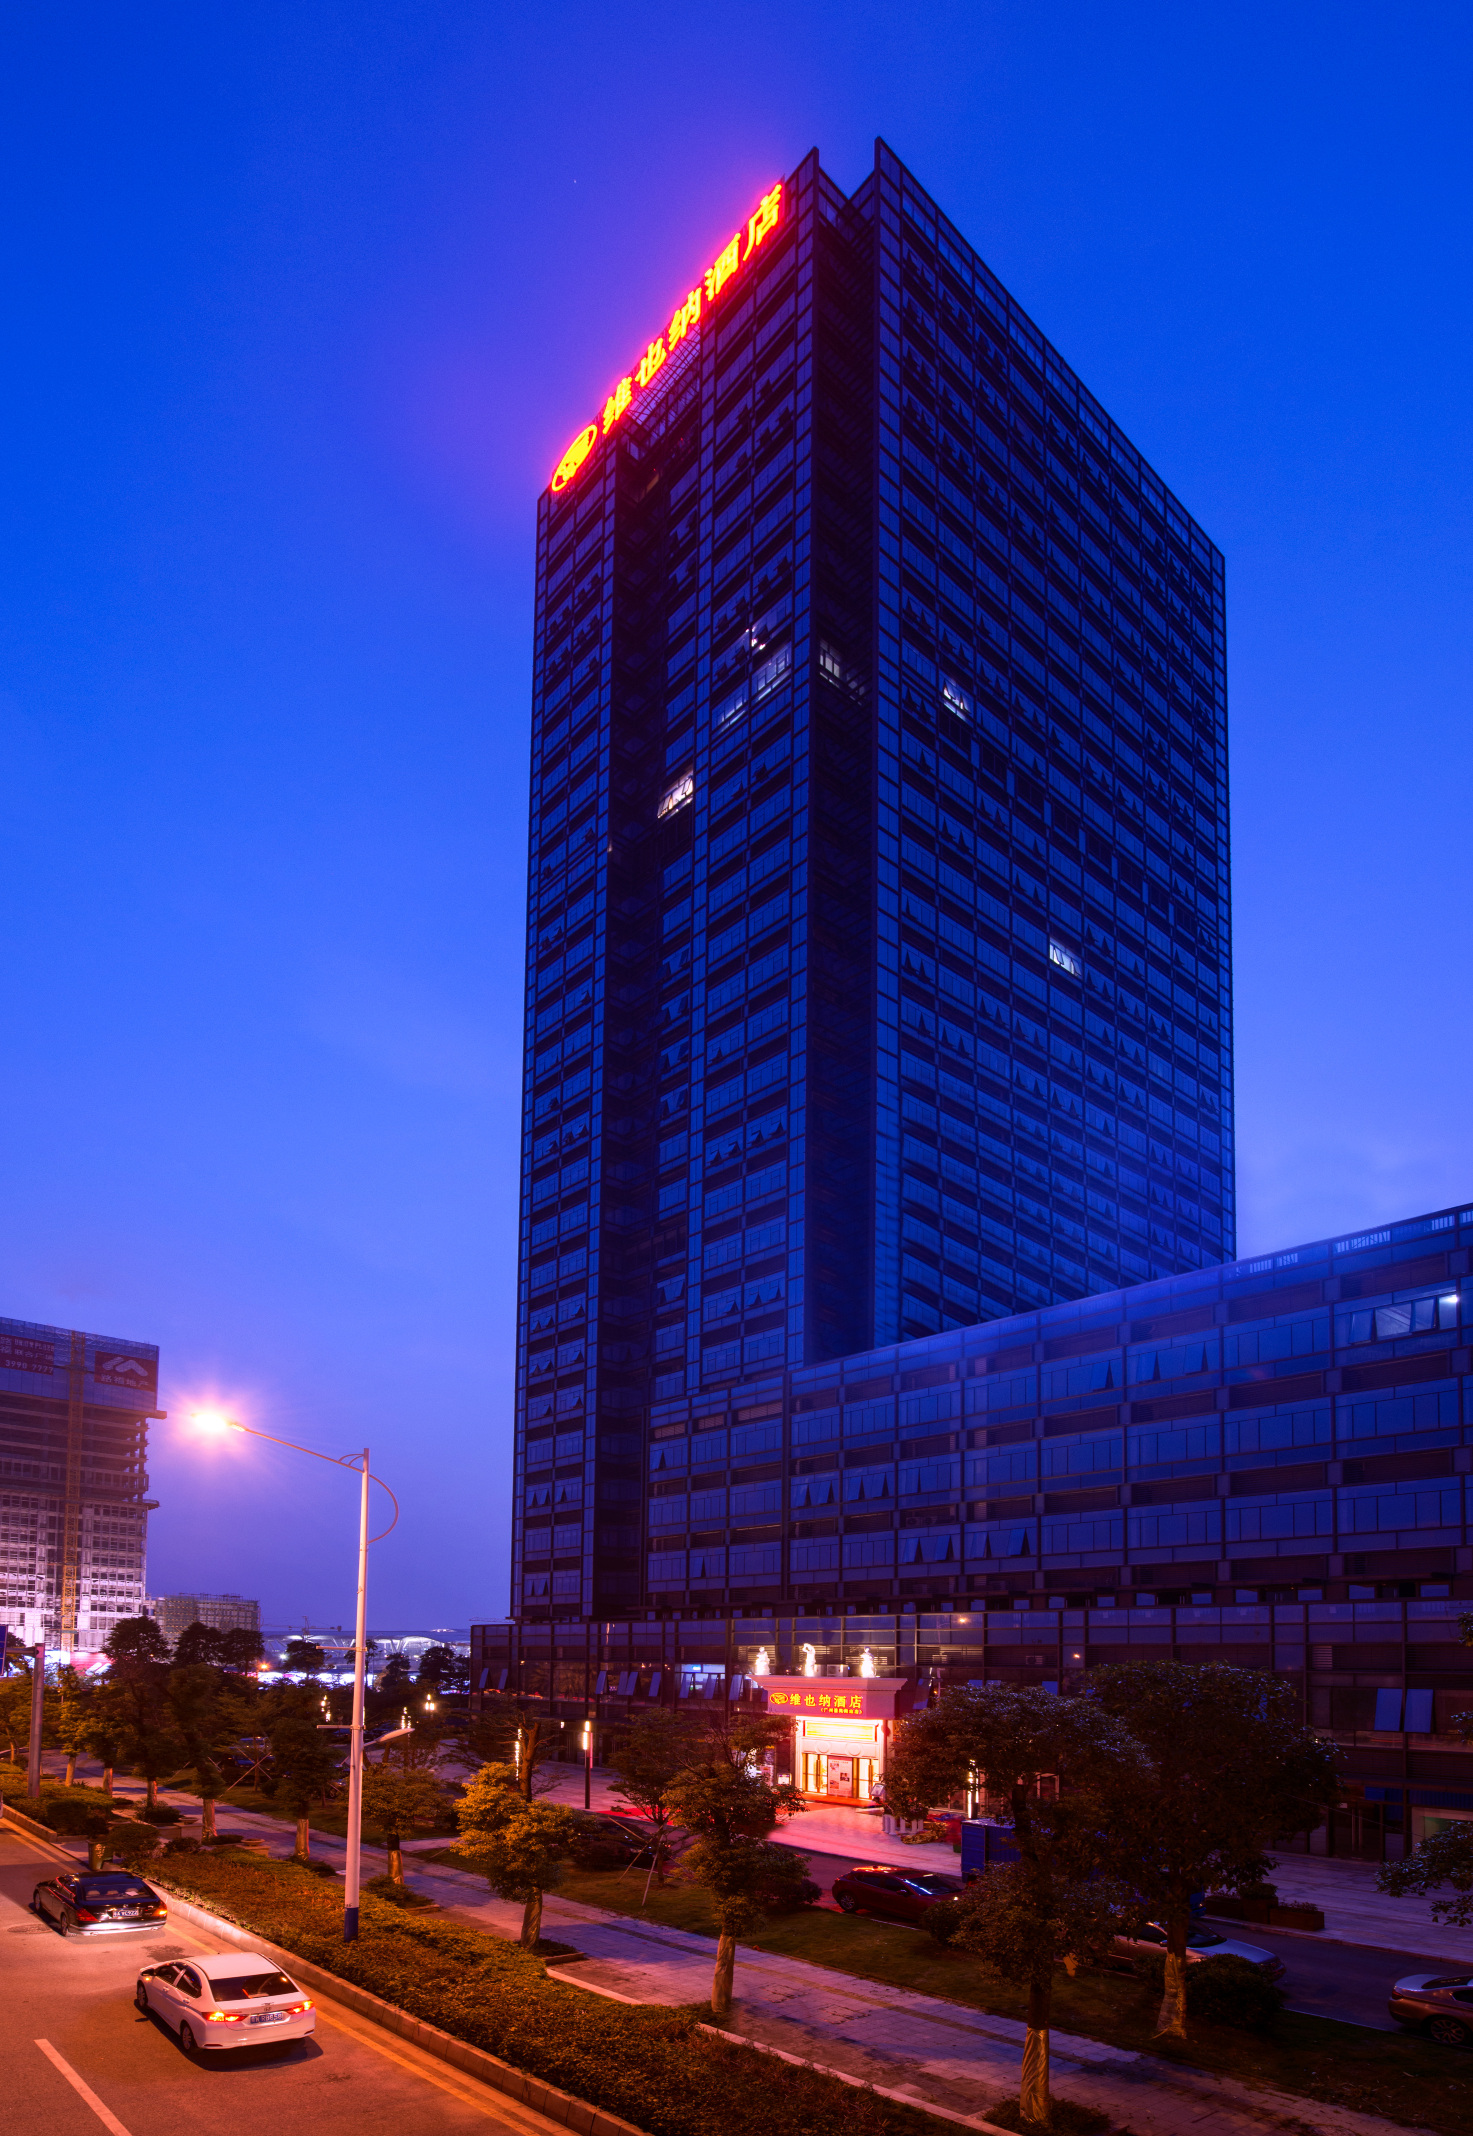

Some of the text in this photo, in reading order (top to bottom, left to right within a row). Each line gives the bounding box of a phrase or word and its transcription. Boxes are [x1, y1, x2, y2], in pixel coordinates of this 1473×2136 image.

[603, 184, 782, 434] 维也纳酒店
[789, 1693, 862, 1709] 维也纳酒店
